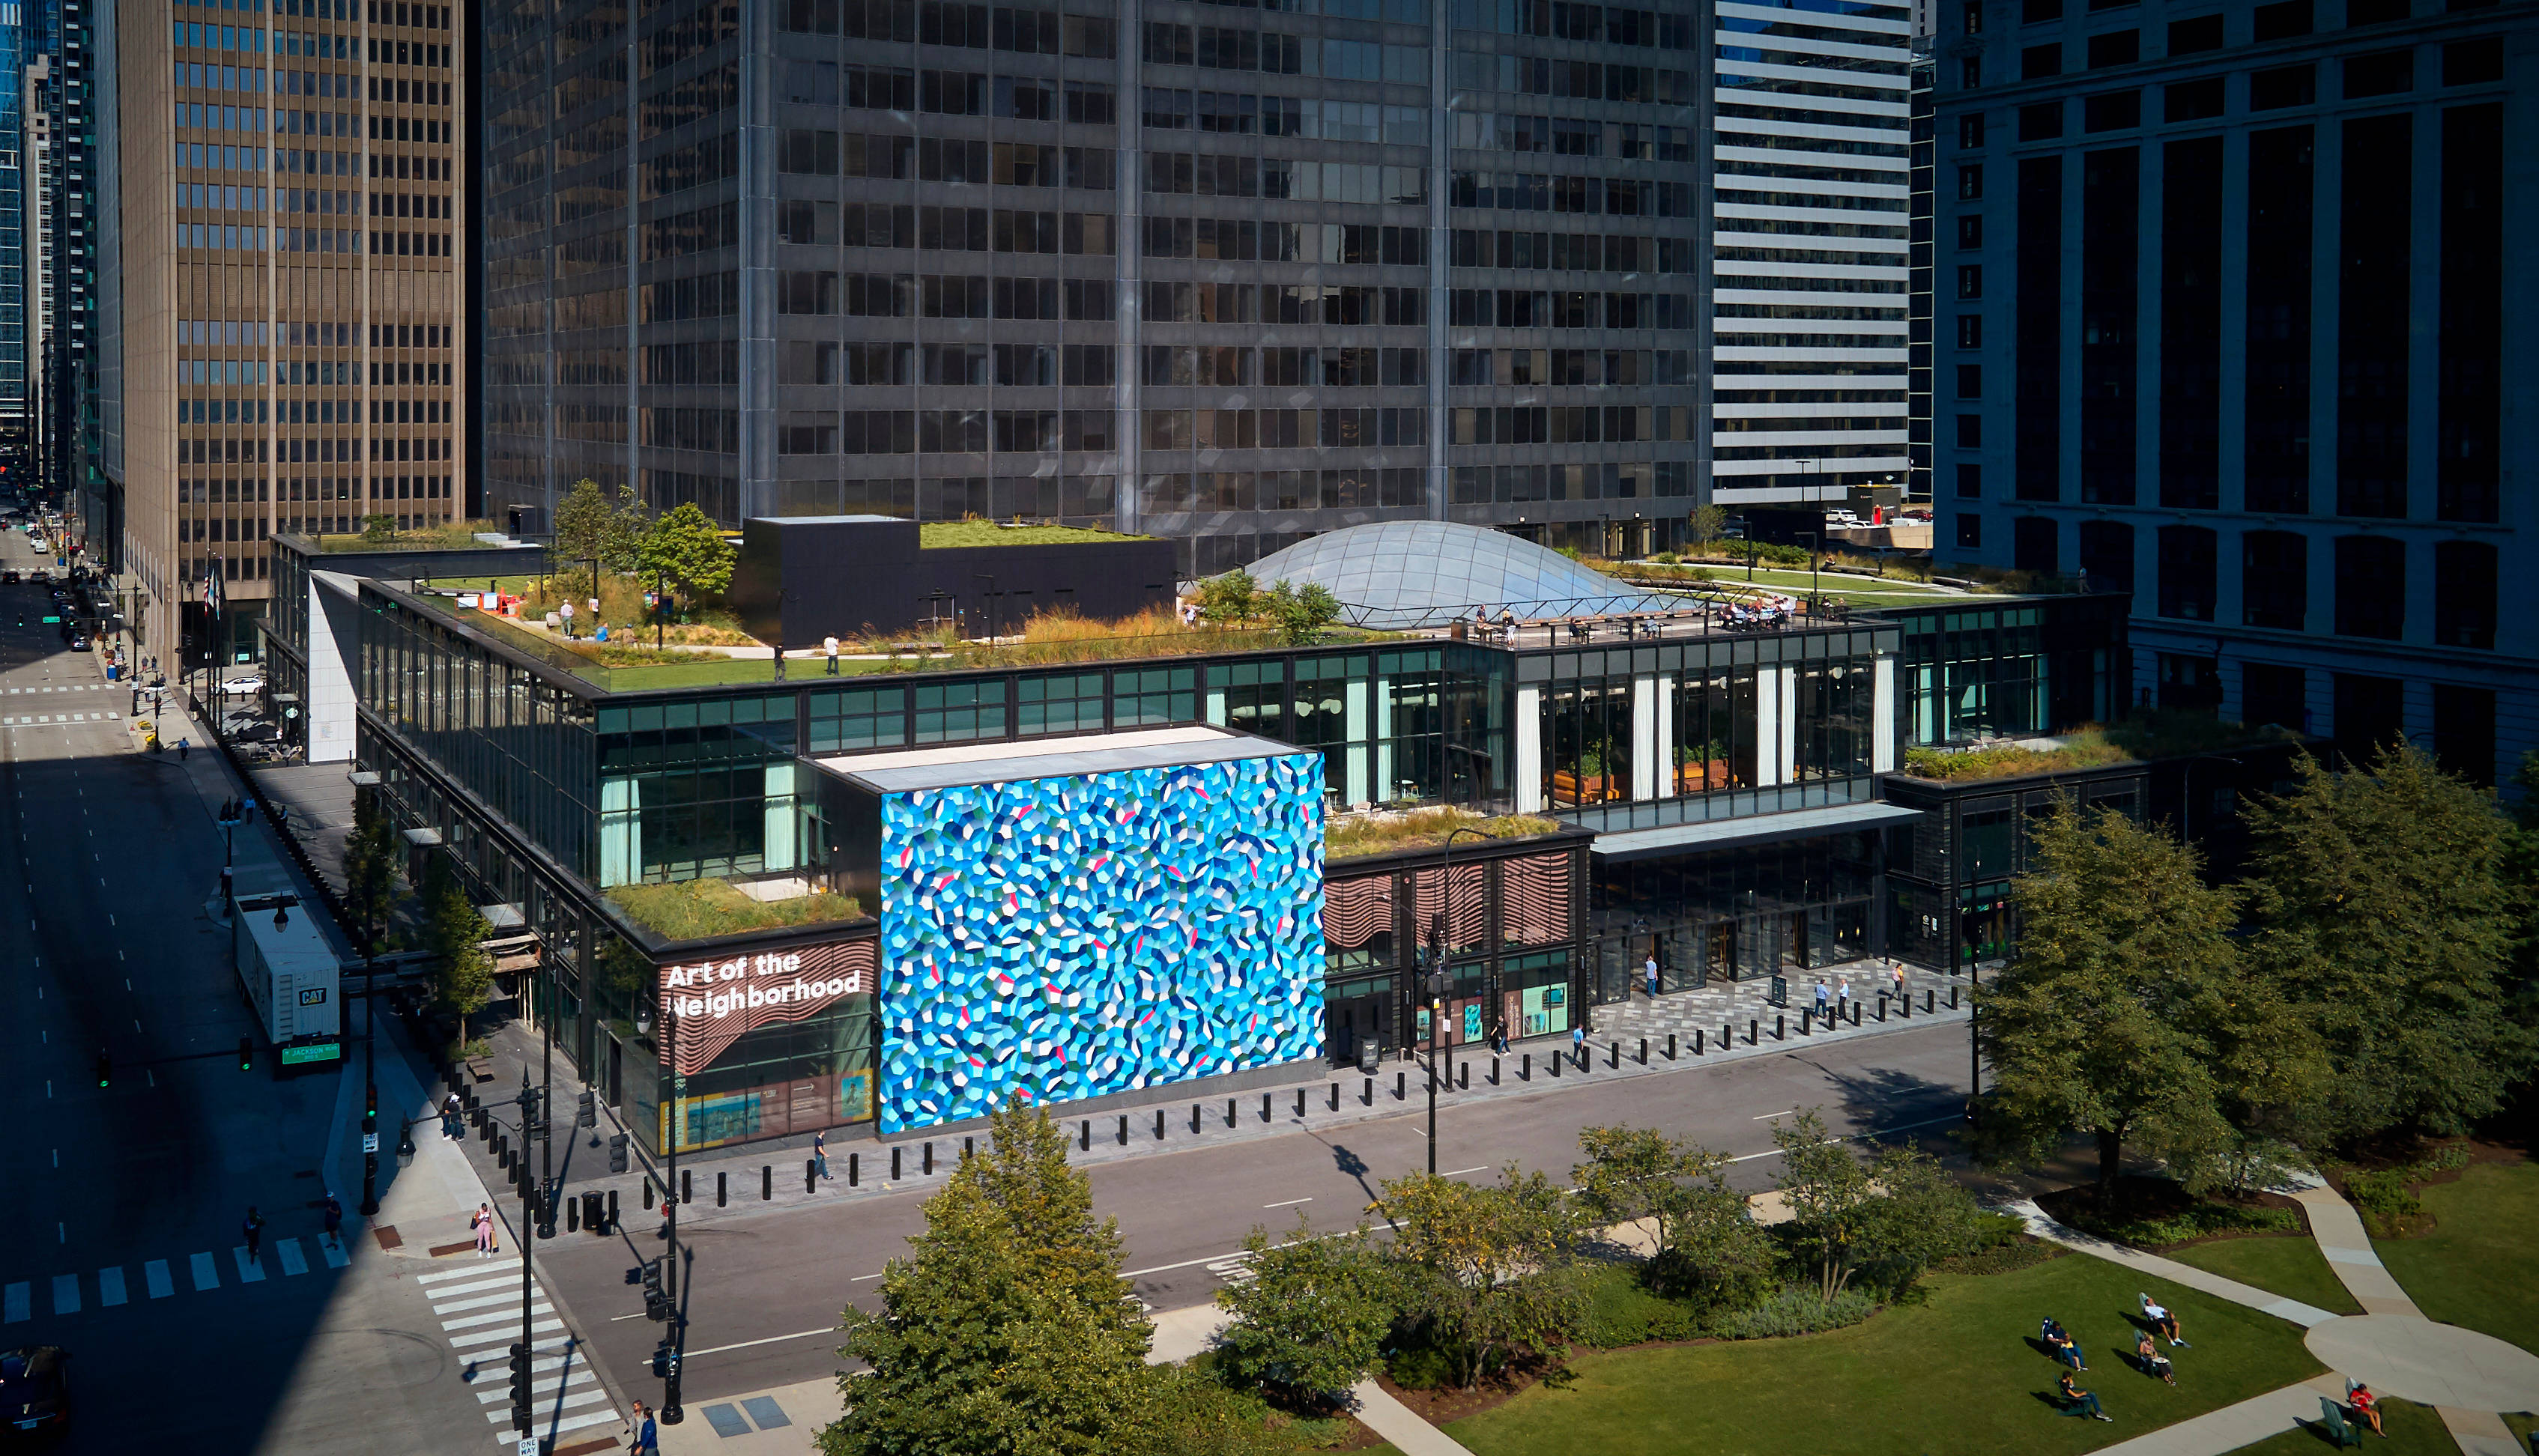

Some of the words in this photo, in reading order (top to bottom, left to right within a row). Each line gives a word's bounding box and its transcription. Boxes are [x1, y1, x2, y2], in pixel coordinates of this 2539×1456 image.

[666, 962, 713, 988] Art
[719, 956, 748, 980] of
[755, 952, 800, 975] the
[302, 989, 324, 1004] CAT
[667, 970, 861, 1019] Neighborhood
[292, 1048, 324, 1056] JACKSON
[521, 1440, 536, 1449] ONE
[521, 1446, 536, 1455] WAY
